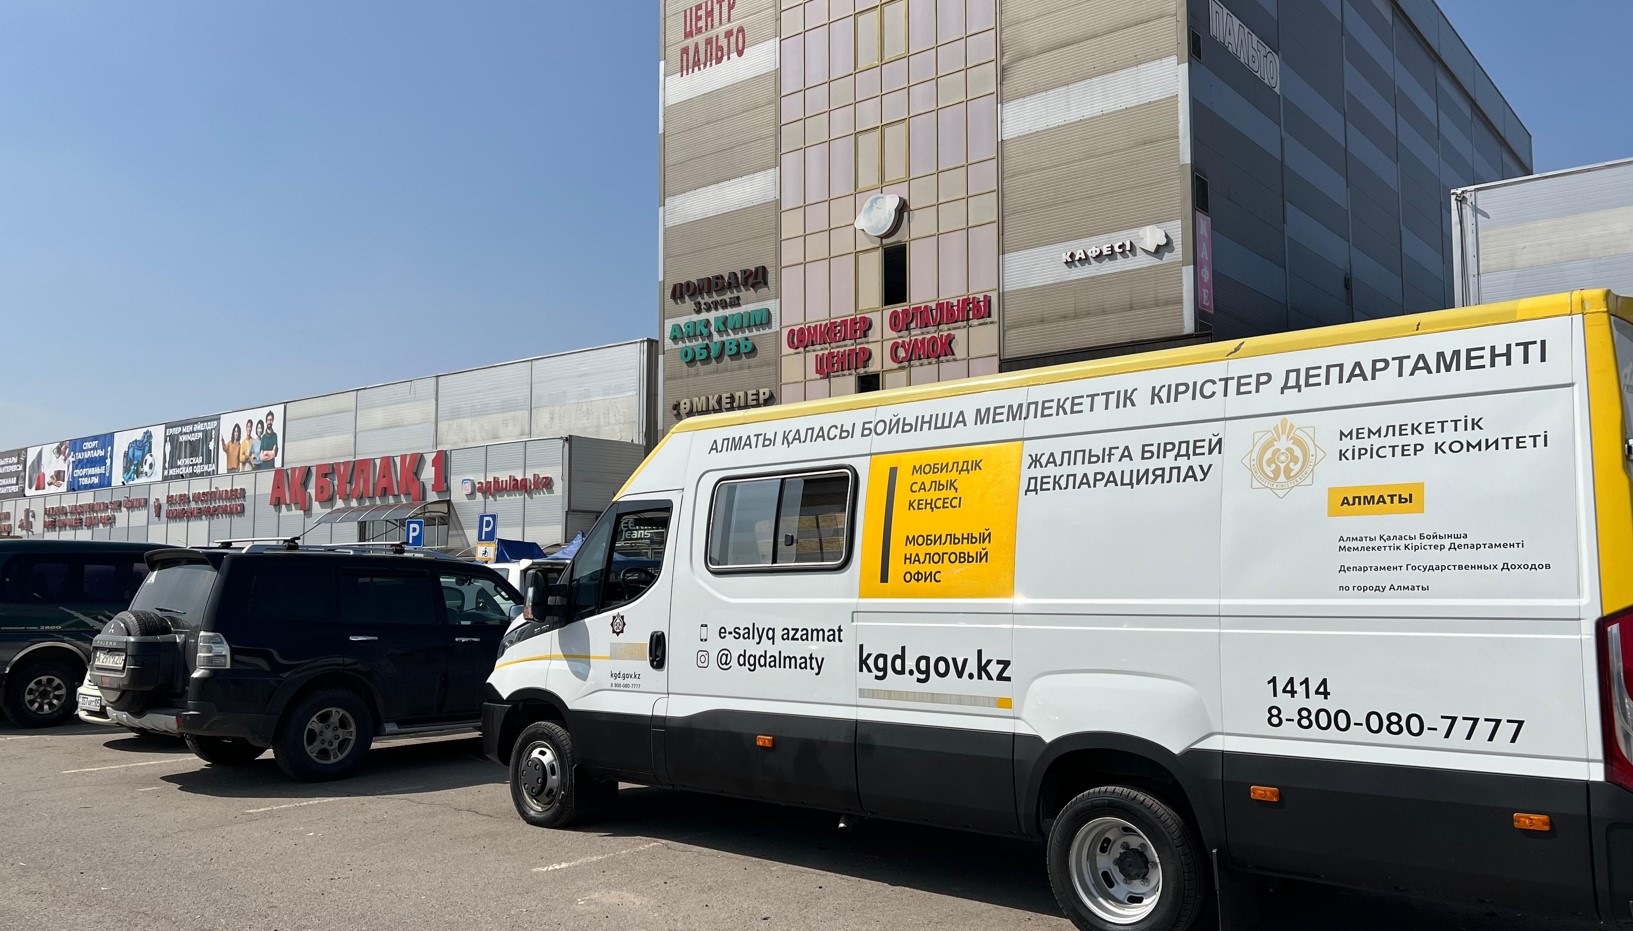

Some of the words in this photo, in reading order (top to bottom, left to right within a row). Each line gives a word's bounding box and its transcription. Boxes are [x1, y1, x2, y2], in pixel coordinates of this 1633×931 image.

[684, 0, 736, 40] ЦЕНТР
[680, 26, 746, 78] ПАЛЬТО
[1210, 0, 1278, 89] ПАЛЬТО
[1062, 240, 1132, 263] КАФЕСІ
[1200, 218, 1210, 306] КАФЕ
[670, 265, 769, 300] ЛОМБАРД
[669, 318, 713, 340] АЯҚ
[714, 308, 771, 332] КИІМ
[787, 315, 872, 350] СӨМКЕЛЕР
[889, 294, 991, 332] ОРТАЛЫҒЫ
[680, 336, 754, 363] ОБУВЬ
[815, 346, 872, 379] ЦЕНТР
[890, 333, 955, 364] СУМОК
[708, 431, 777, 455] АЛМАТЫ
[781, 423, 855, 449] ҚАЛАСЫ
[860, 410, 968, 438] БОЙЫНША
[973, 387, 1138, 425] МЕМЛЕКЕТТІК
[1149, 371, 1273, 405] КІРІСТЕР
[1280, 338, 1547, 394] ДЕПАРТАМЕНТІ
[83, 441, 98, 450] СПОРТ
[1027, 445, 1133, 469] ЖАЛПЫҒА
[1140, 433, 1222, 461] БІРДЕЙ
[911, 459, 983, 476] МОБИЛДІК
[79, 477, 99, 486] ТОВАРЫ
[269, 466, 308, 511] АҚ
[315, 452, 423, 503] БҰЛАҚ
[431, 450, 447, 492] 1
[477, 474, 551, 496] aqbulaq.kz
[909, 479, 958, 493] САЛЫҚ
[1024, 464, 1213, 496] ДЕКЛАРАЦИЯЛАУ
[908, 497, 962, 512] КЕҢСЕСІ
[1340, 493, 1413, 507] АЛМАТЫ
[409, 523, 420, 544] P
[482, 516, 493, 540] P
[905, 528, 992, 547] МОБИЛЬНЫЙ
[1338, 535, 1376, 543] Алматы
[1379, 533, 1417, 543] Қаласы
[1419, 531, 1468, 540] Бойынша
[903, 547, 989, 565] НАЛОГОВЫЙ
[1338, 543, 1401, 552] Мемлекеттік
[1404, 542, 1446, 553] Кірістер
[1448, 540, 1525, 551] Департаменті
[903, 570, 942, 583] ОФИС
[1338, 564, 1403, 573] Департамент
[1405, 563, 1498, 573] Государственных
[1500, 562, 1551, 571] Доходов
[1352, 585, 1387, 594] городу
[1389, 583, 1429, 591] Алматы
[718, 622, 776, 645] e-salyq
[781, 624, 843, 643] azamat
[737, 649, 825, 676] dgdalmaty
[858, 643, 1012, 683] kgd.gov.kz
[610, 670, 641, 681] kgd.gov.kz
[1266, 676, 1331, 700] 1414
[1266, 705, 1526, 743] 8-800-080-7777
